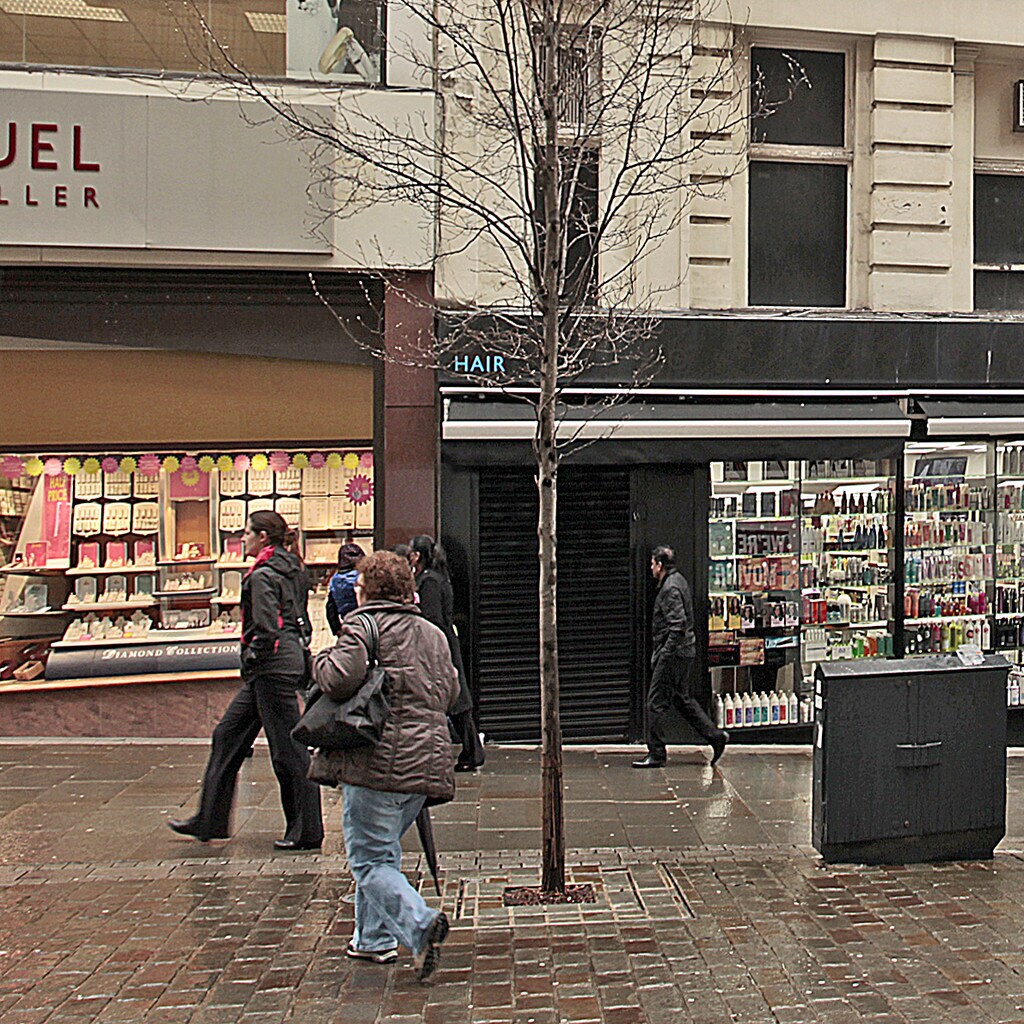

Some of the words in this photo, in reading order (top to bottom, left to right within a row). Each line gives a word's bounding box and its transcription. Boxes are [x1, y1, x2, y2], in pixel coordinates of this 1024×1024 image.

[454, 355, 506, 373] HAIR
[48, 488, 67, 503] PRICE
[101, 649, 164, 660] DIAMOND
[165, 645, 239, 656] COLLECTION
